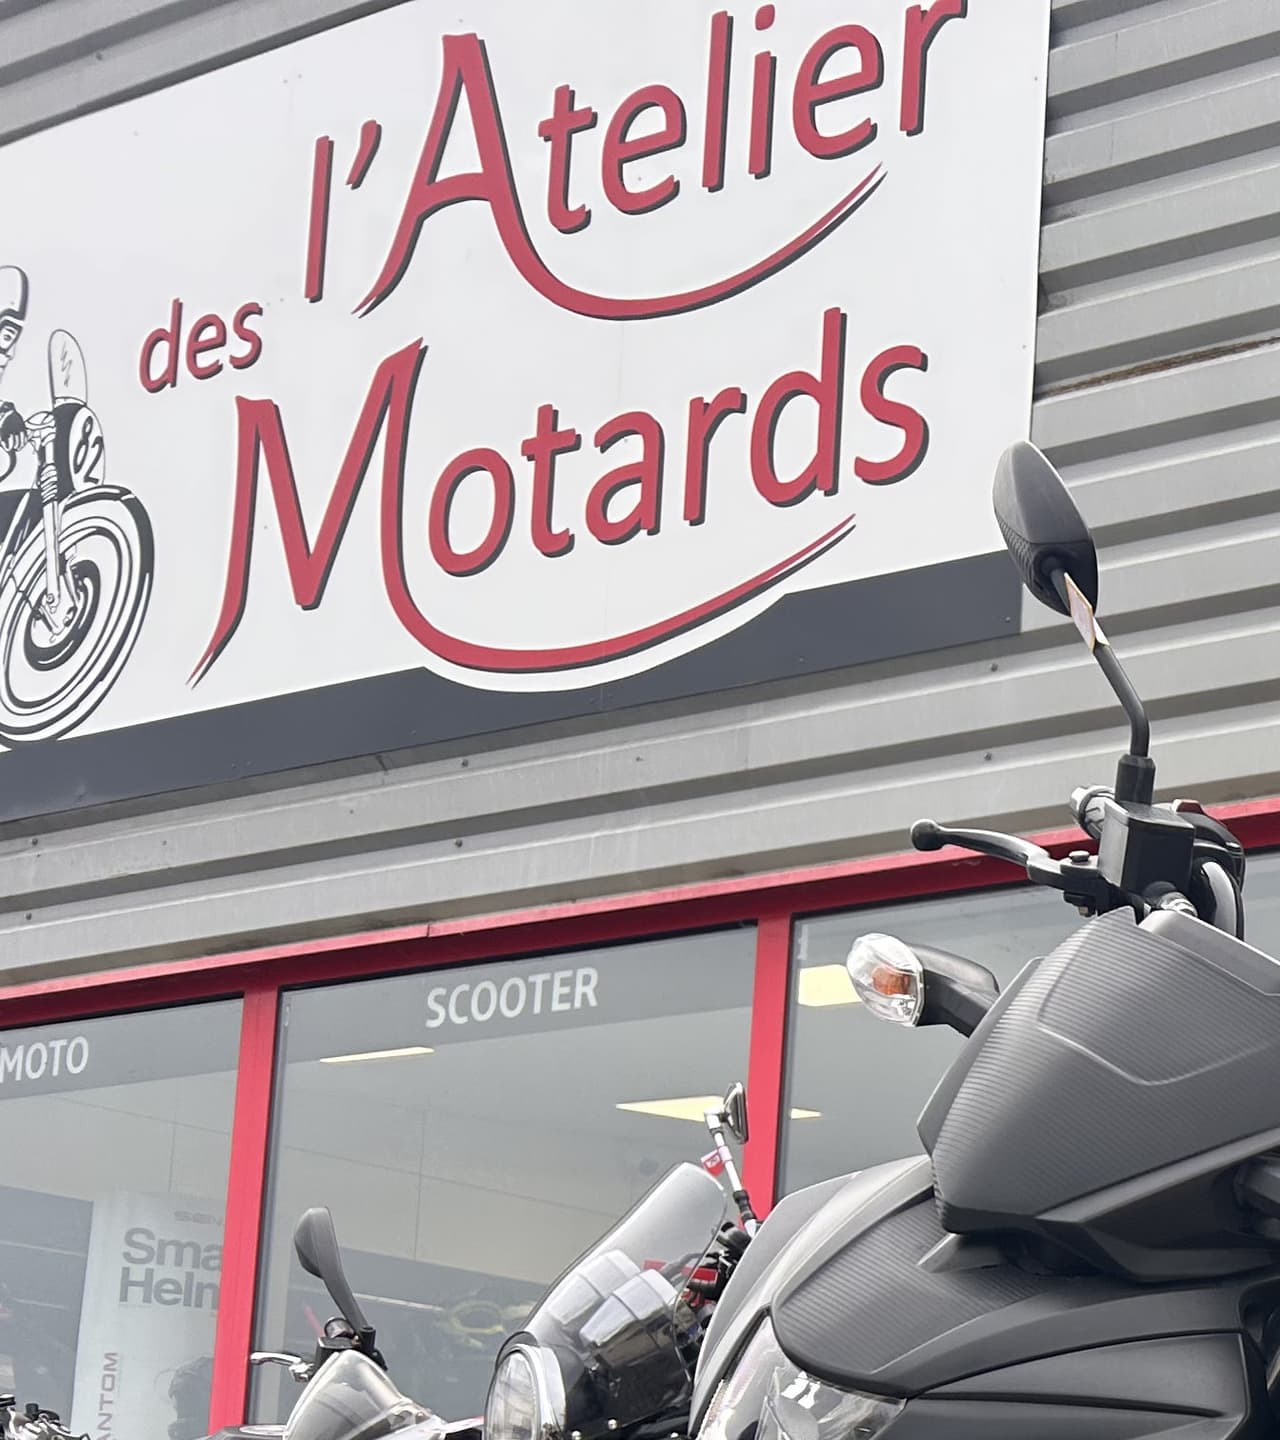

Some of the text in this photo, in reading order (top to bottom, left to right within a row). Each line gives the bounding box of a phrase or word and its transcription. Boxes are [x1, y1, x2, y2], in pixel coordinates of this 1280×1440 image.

[303, 0, 967, 320] l'Atelier
[139, 297, 264, 393] des
[186, 307, 929, 687] Motards
[425, 967, 599, 1028] SCOOTER
[0, 1036, 89, 1083] MOTO
